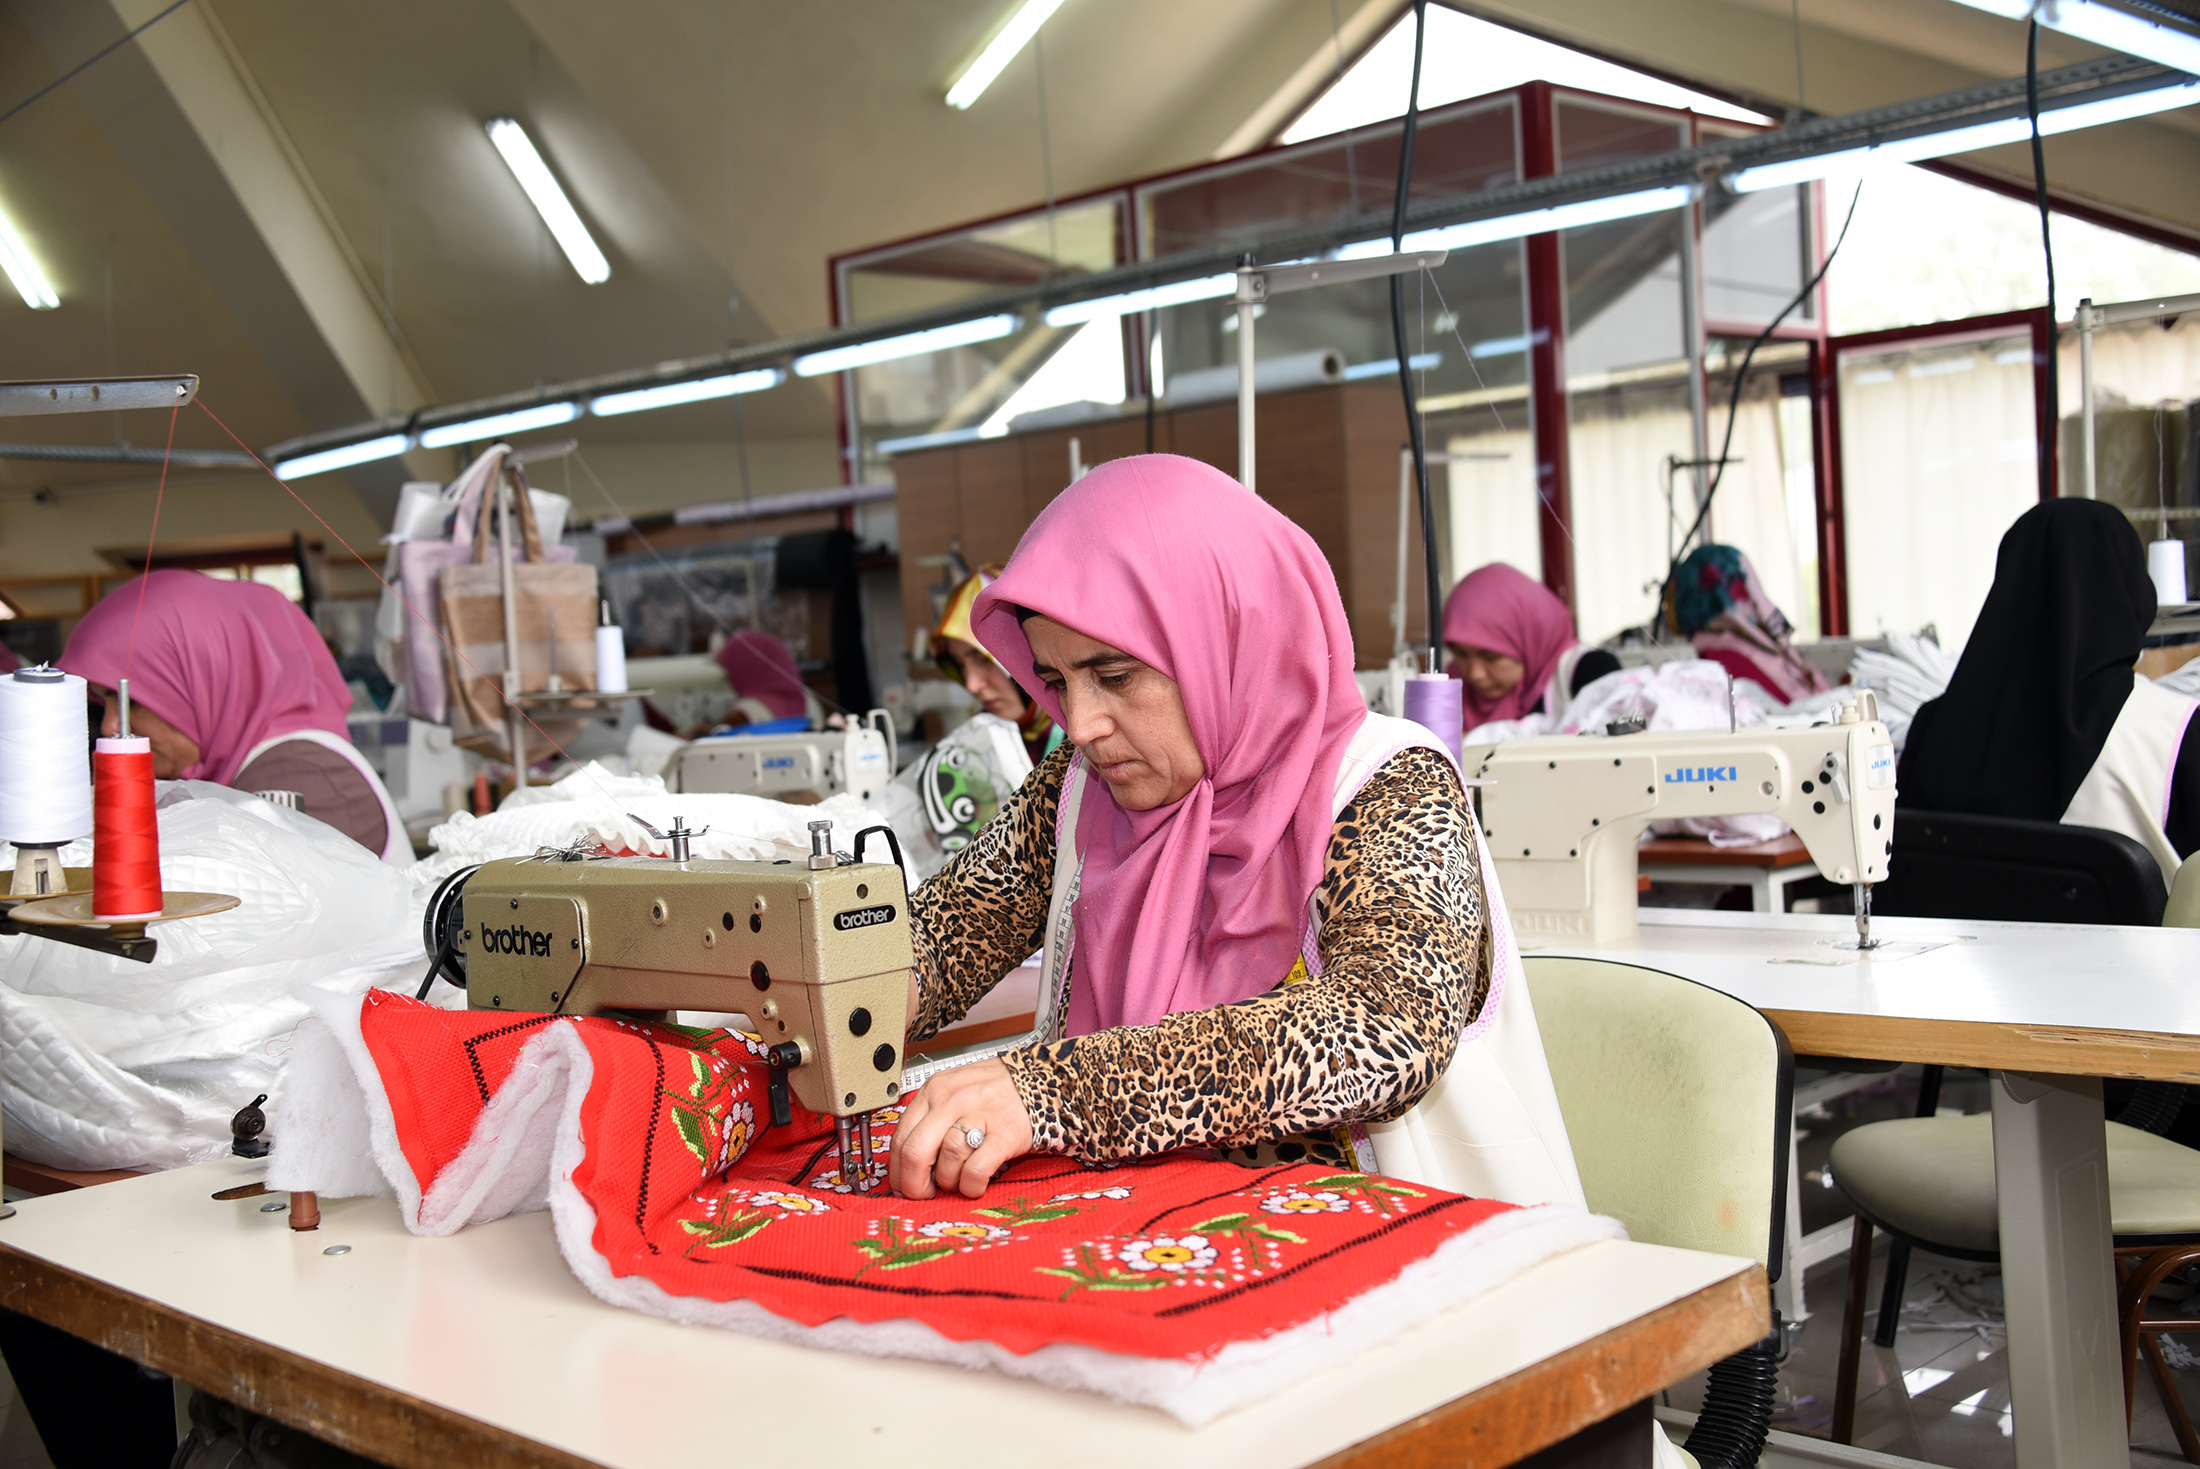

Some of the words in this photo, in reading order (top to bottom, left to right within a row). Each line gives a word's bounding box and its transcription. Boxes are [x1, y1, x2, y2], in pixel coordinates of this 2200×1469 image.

[1871, 758, 1891, 769] JUKI
[1665, 766, 1737, 783] JUKI
[840, 909, 890, 929] brother
[480, 921, 553, 957] brother
[1291, 969, 1302, 979] 109
